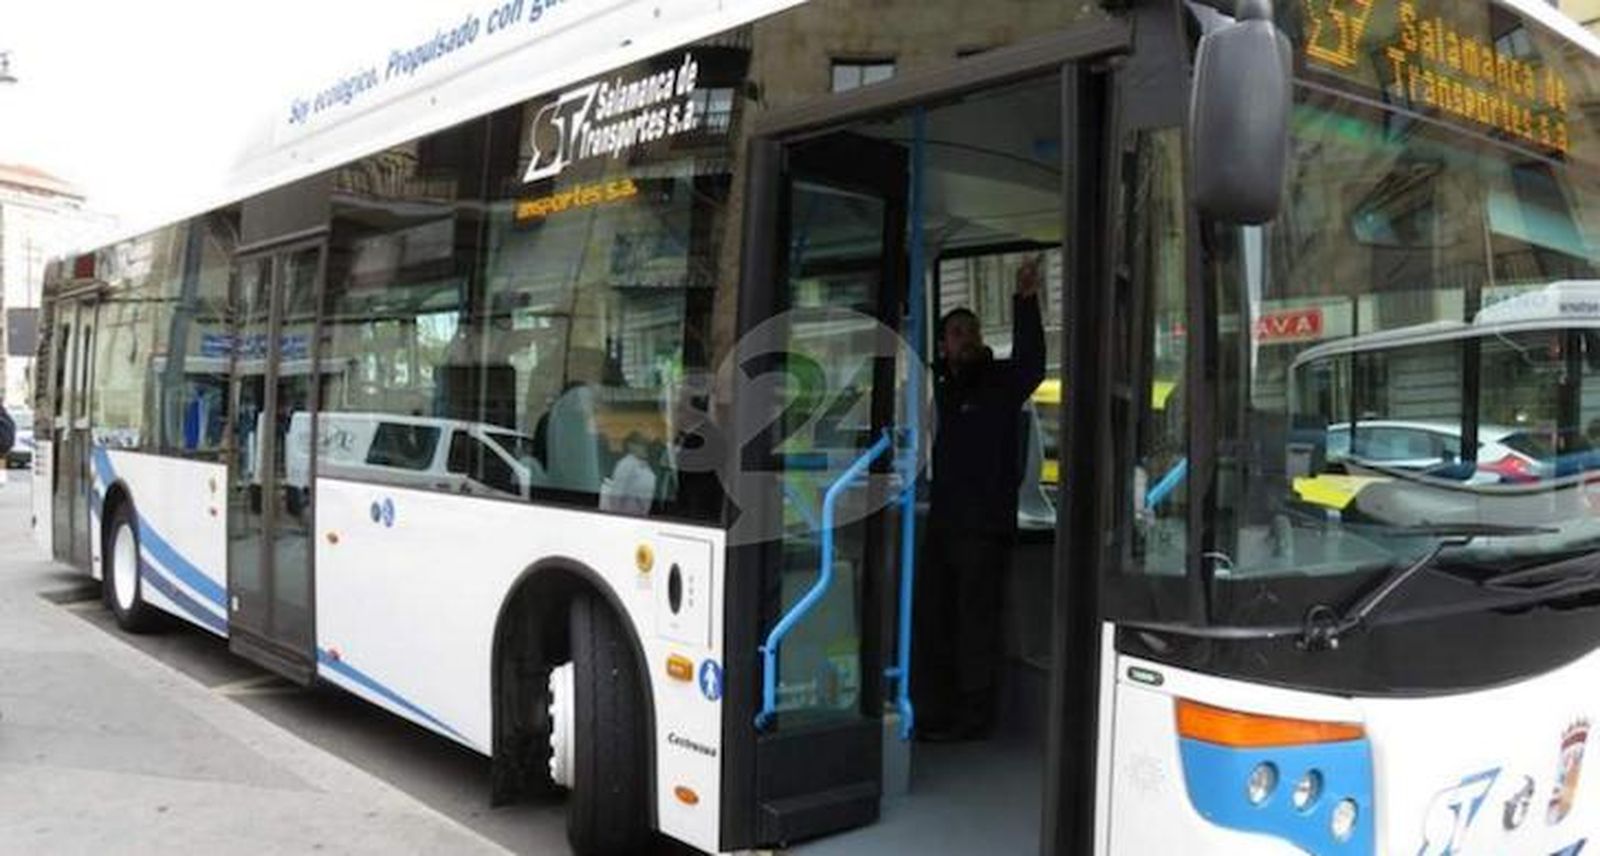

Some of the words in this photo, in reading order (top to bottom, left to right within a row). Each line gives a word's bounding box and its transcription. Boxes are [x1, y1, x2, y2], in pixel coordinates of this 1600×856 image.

[385, 14, 480, 82] Propulsado
[487, 0, 523, 35] con
[1399, 2, 1536, 101] Salamanca
[1544, 67, 1568, 113] de
[596, 69, 676, 120] Salamanca
[677, 52, 698, 96] de
[1386, 46, 1533, 140] Transportes
[579, 108, 668, 160] Transportes
[668, 100, 699, 135] s.a.
